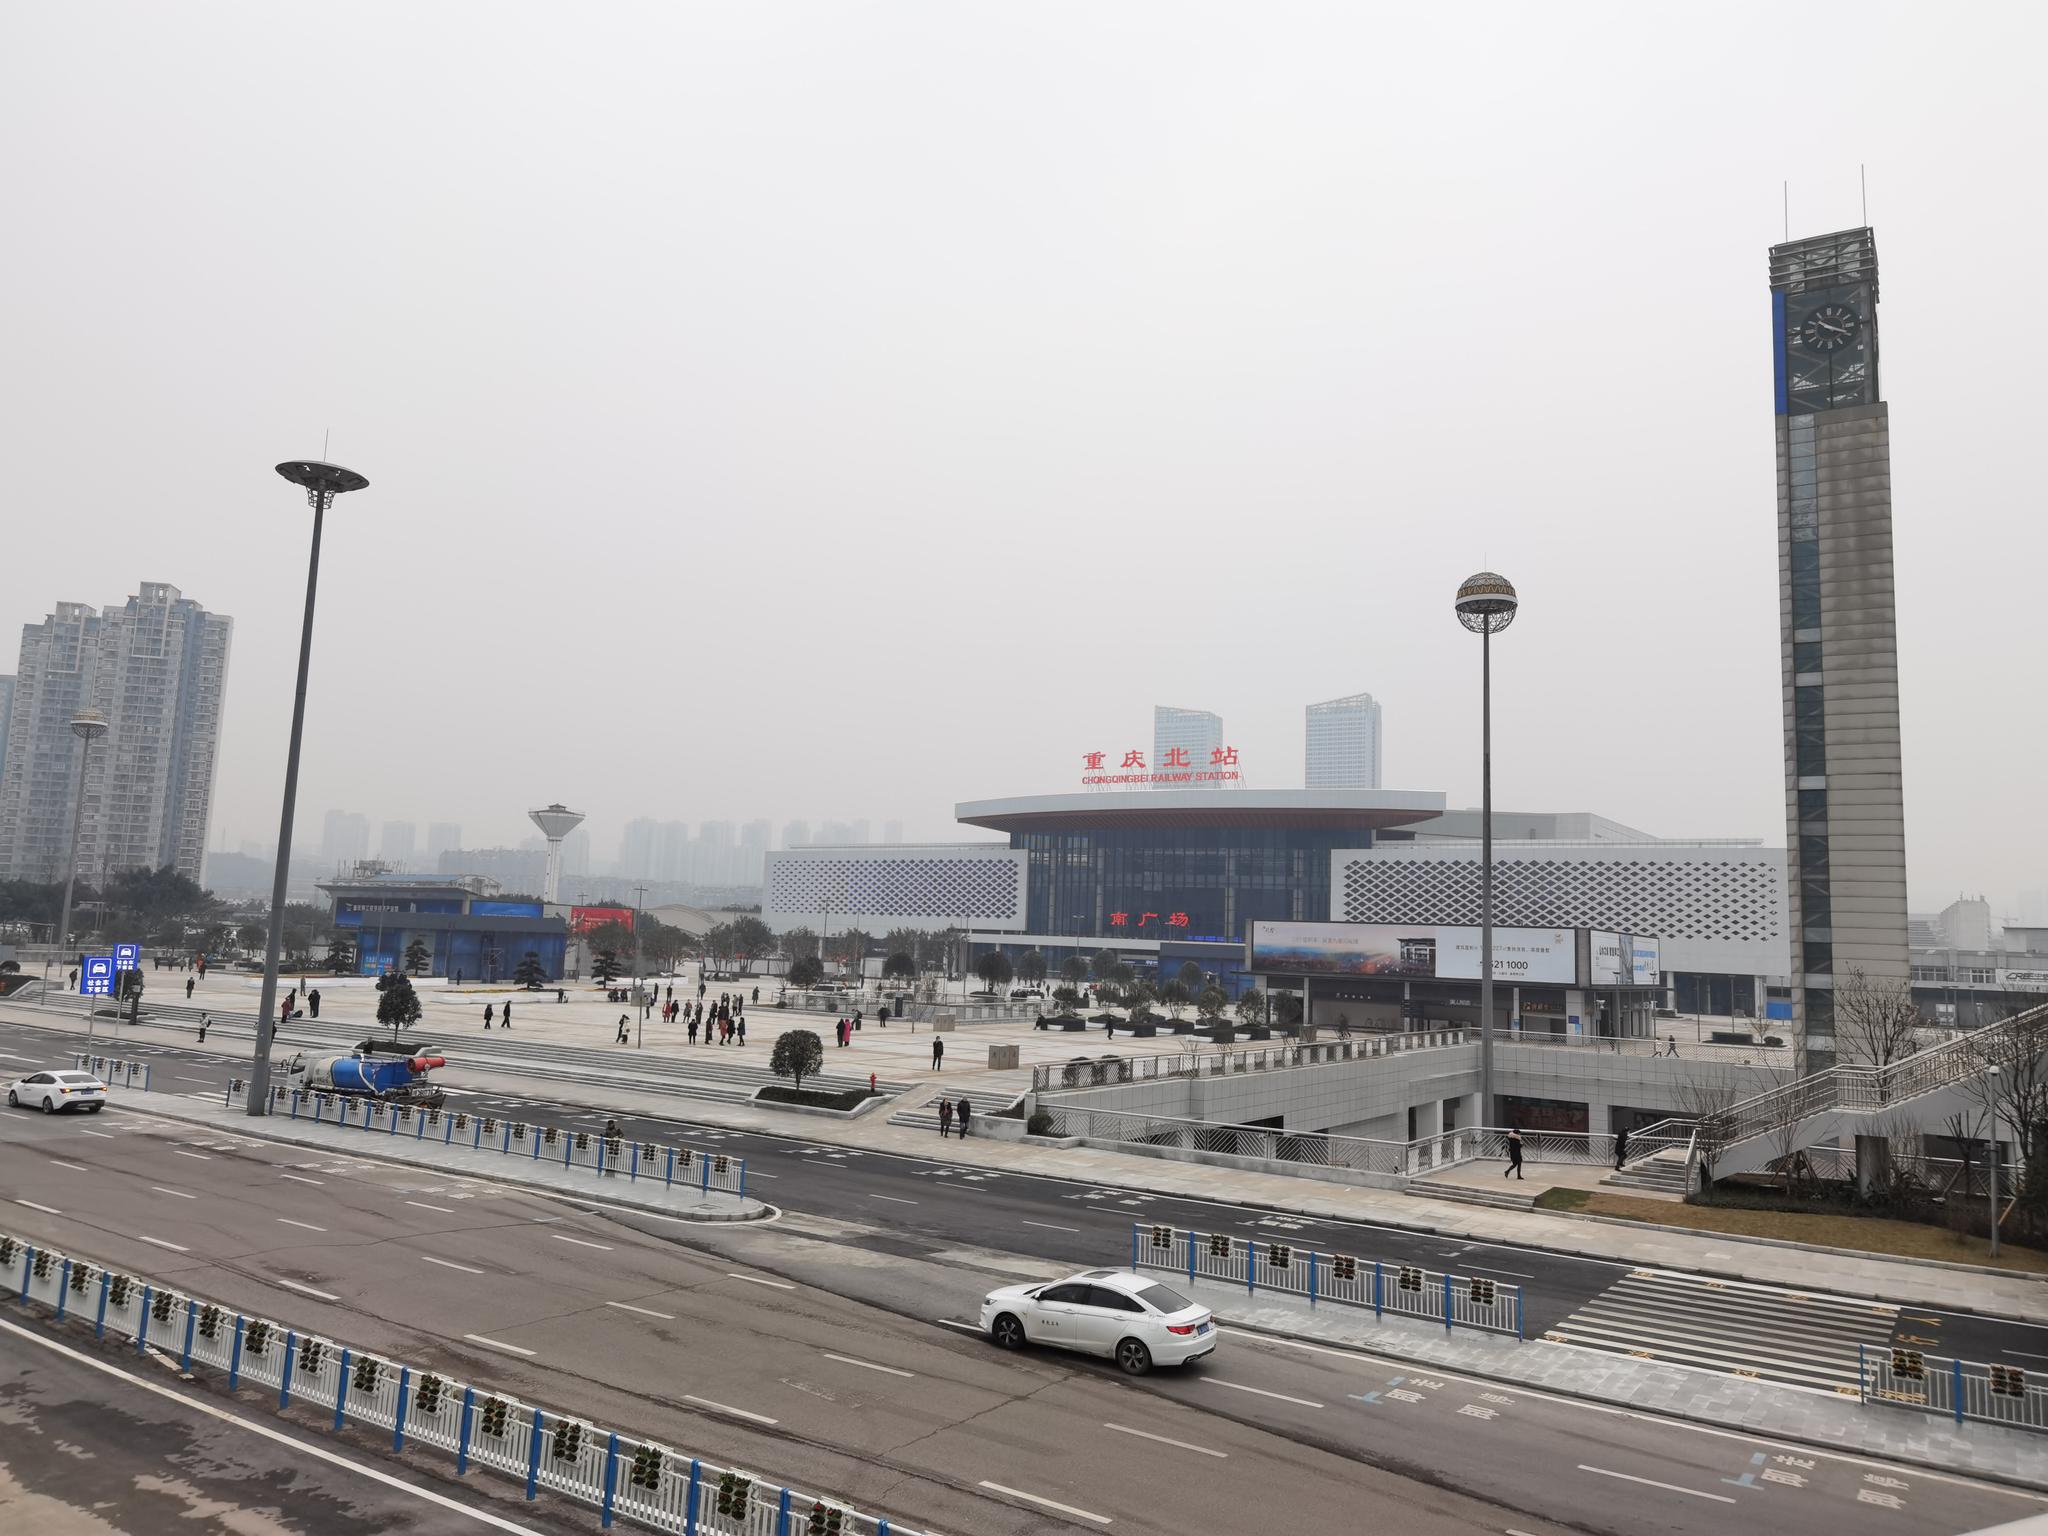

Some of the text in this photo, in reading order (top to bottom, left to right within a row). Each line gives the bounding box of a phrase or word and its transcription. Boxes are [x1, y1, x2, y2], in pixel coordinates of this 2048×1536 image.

[1083, 746, 1239, 770] 重庆北站
[1082, 771, 1239, 785] CHONGQINGBEI RAILWAY STATION
[1110, 911, 1189, 927] 南广场
[1506, 960, 1529, 970] 1000
